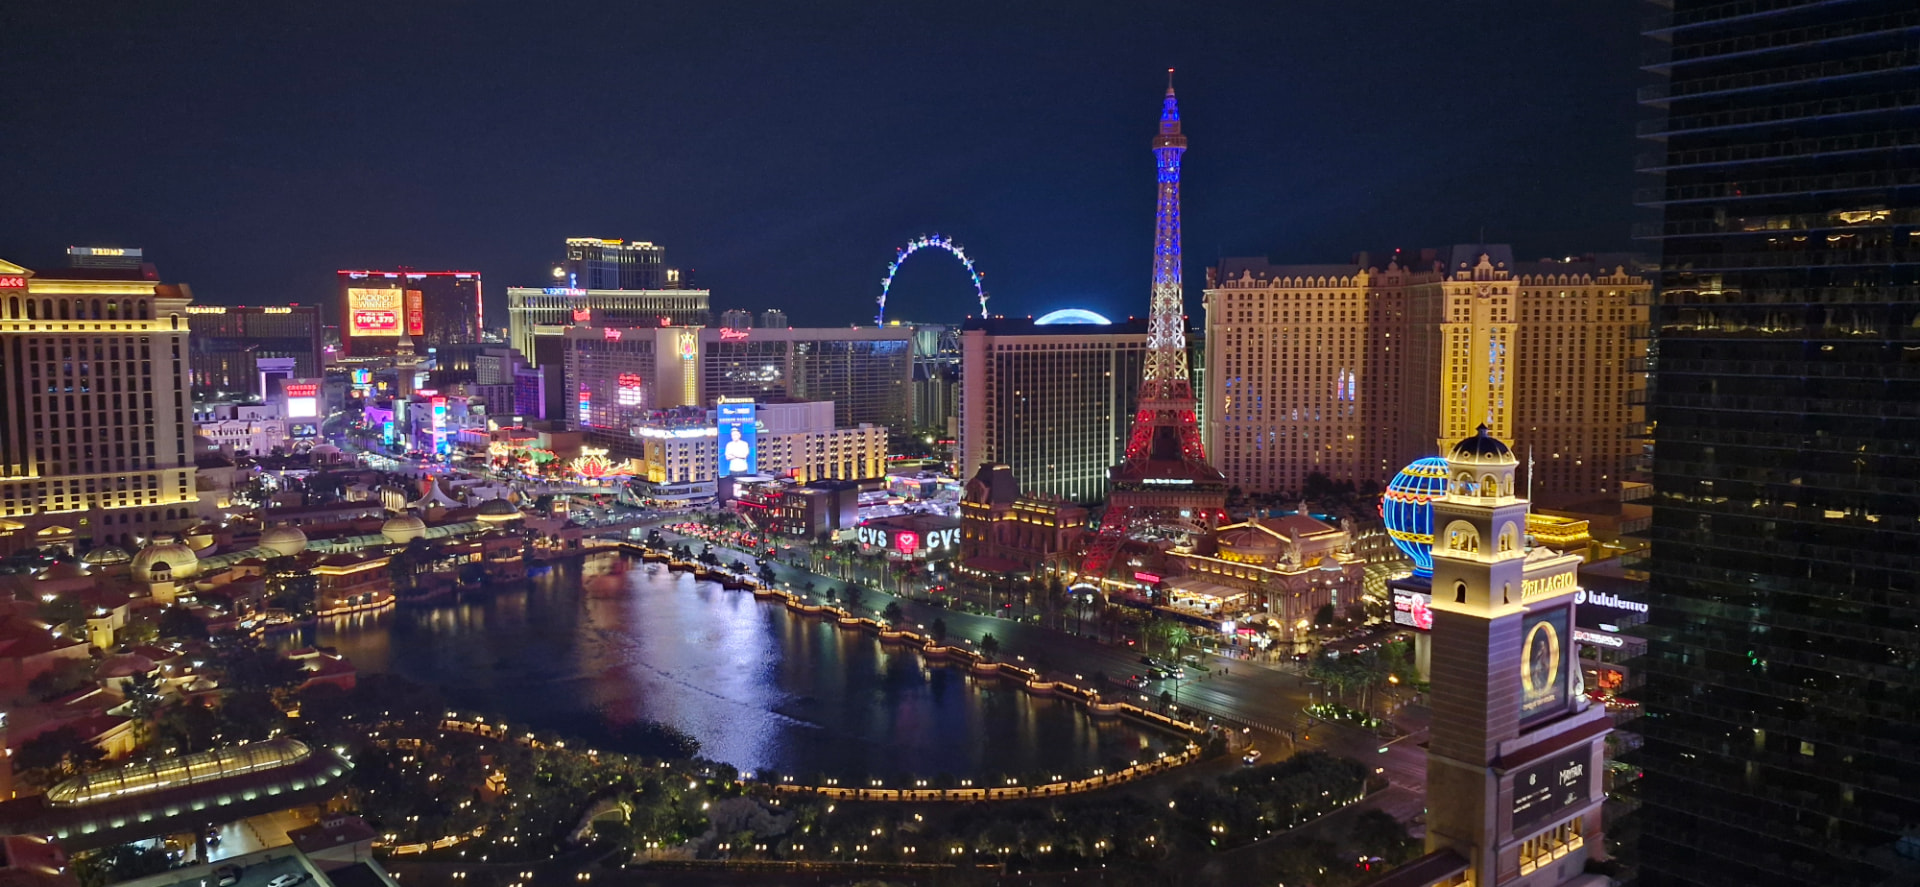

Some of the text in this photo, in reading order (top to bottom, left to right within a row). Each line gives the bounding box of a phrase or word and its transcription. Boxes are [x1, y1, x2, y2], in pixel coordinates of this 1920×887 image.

[91, 247, 125, 256] TRUMP
[543, 287, 587, 296] VENETIAN
[358, 294, 394, 302] JACKPOT
[358, 301, 393, 309] WINNER
[858, 527, 888, 548] CVS
[926, 528, 961, 549] CVS
